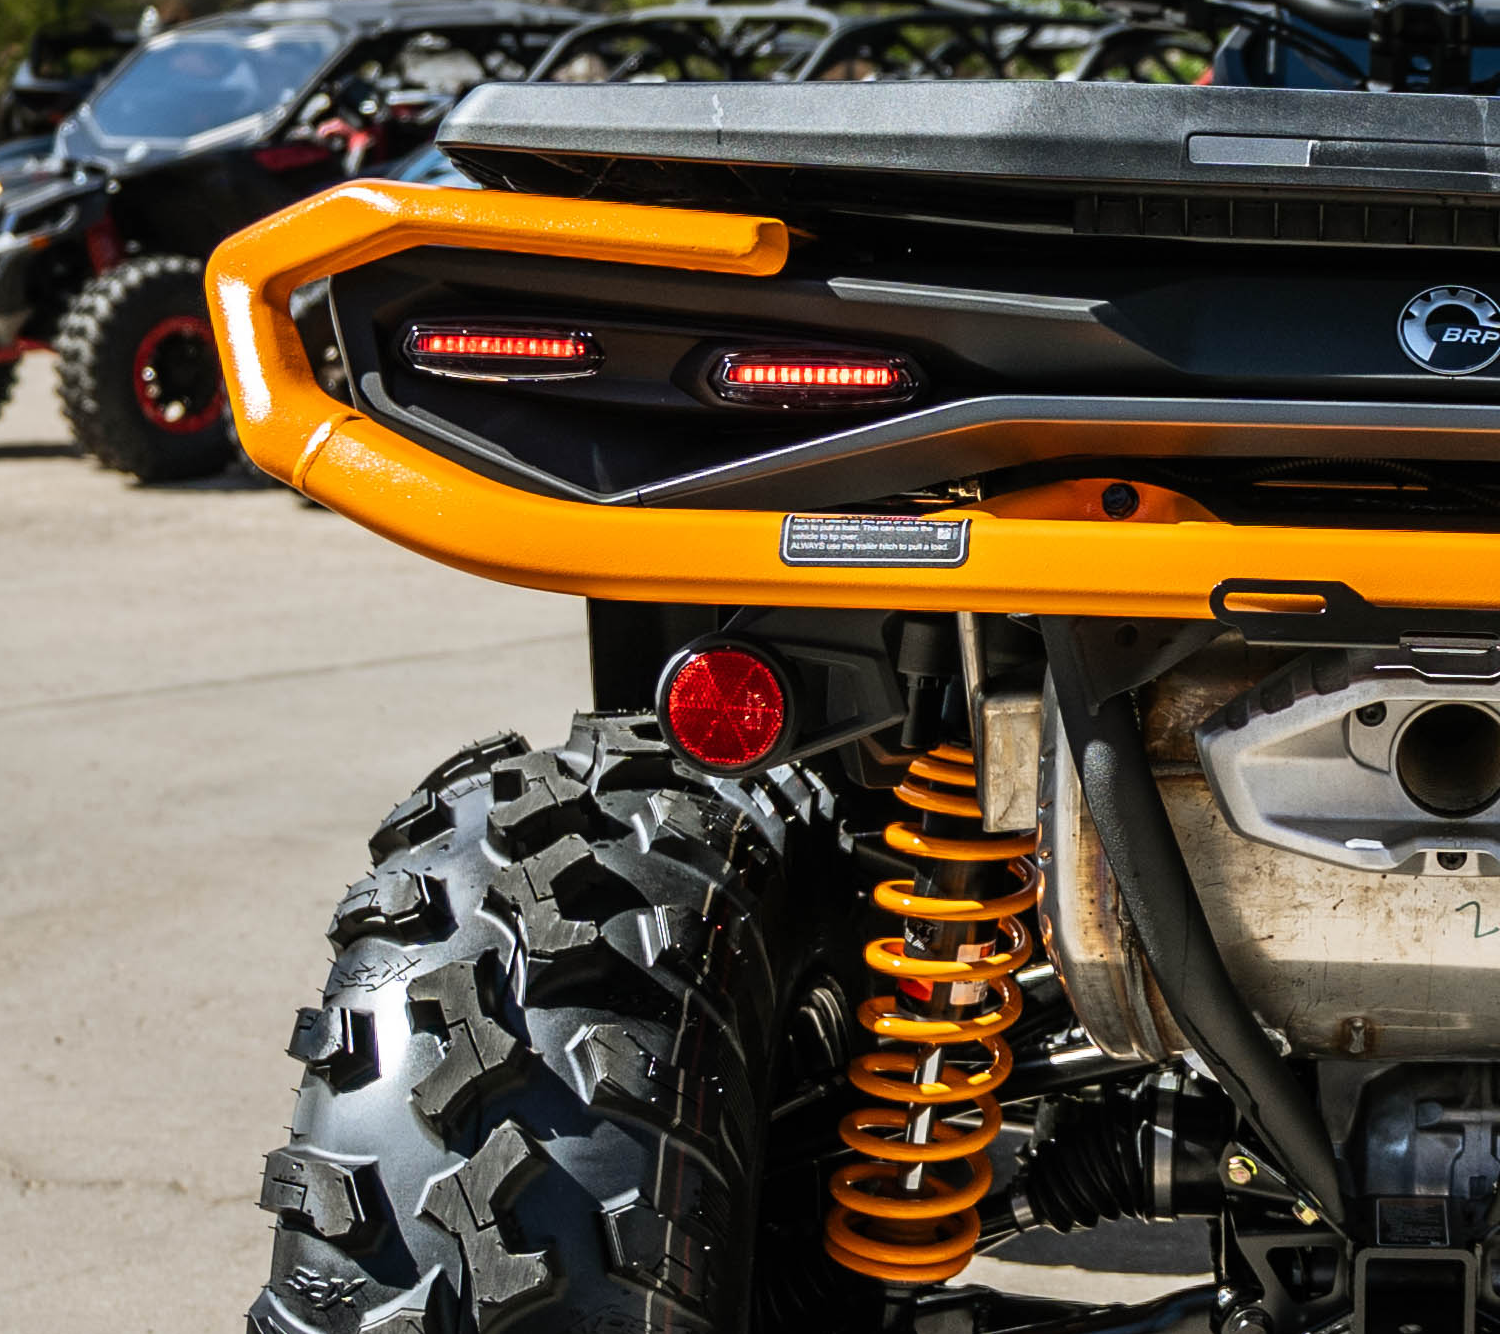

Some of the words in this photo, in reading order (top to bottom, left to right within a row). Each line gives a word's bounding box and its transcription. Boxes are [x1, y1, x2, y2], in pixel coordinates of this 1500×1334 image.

[1442, 327, 1500, 344] BRP
[790, 541, 826, 550] ALWAYS
[898, 543, 907, 551] to
[907, 542, 923, 552] pull
